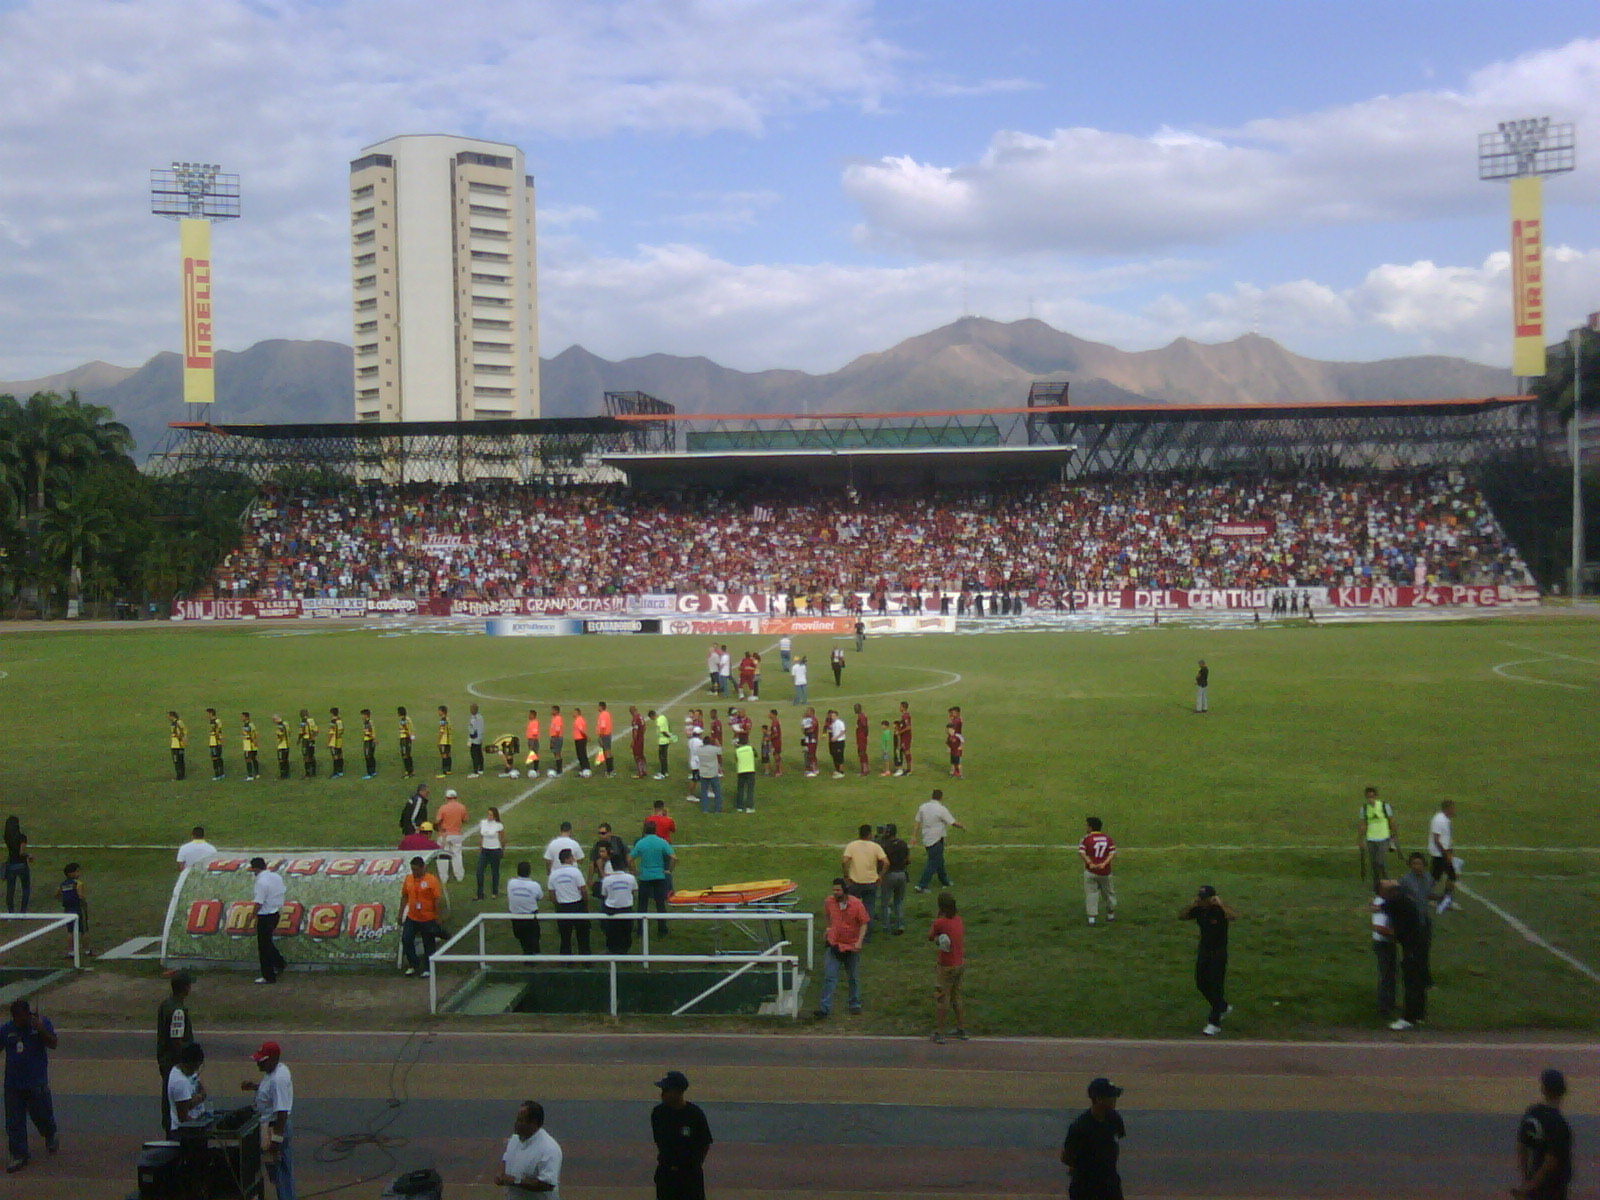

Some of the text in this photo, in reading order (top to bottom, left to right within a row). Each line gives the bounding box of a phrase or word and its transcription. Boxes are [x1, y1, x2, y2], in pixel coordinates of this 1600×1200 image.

[1512, 219, 1543, 337] PIRELLI
[184, 257, 212, 368] PIRELLI
[679, 594, 787, 613] GRAN
[1134, 590, 1178, 609] DEL
[1188, 588, 1266, 609] CENTRO
[1338, 586, 1398, 607] KLAN
[1412, 587, 1440, 606] 24
[176, 601, 203, 618] SAN
[207, 601, 243, 619] JOSE
[1093, 841, 1108, 858] 17
[192, 902, 381, 935] IMECA
